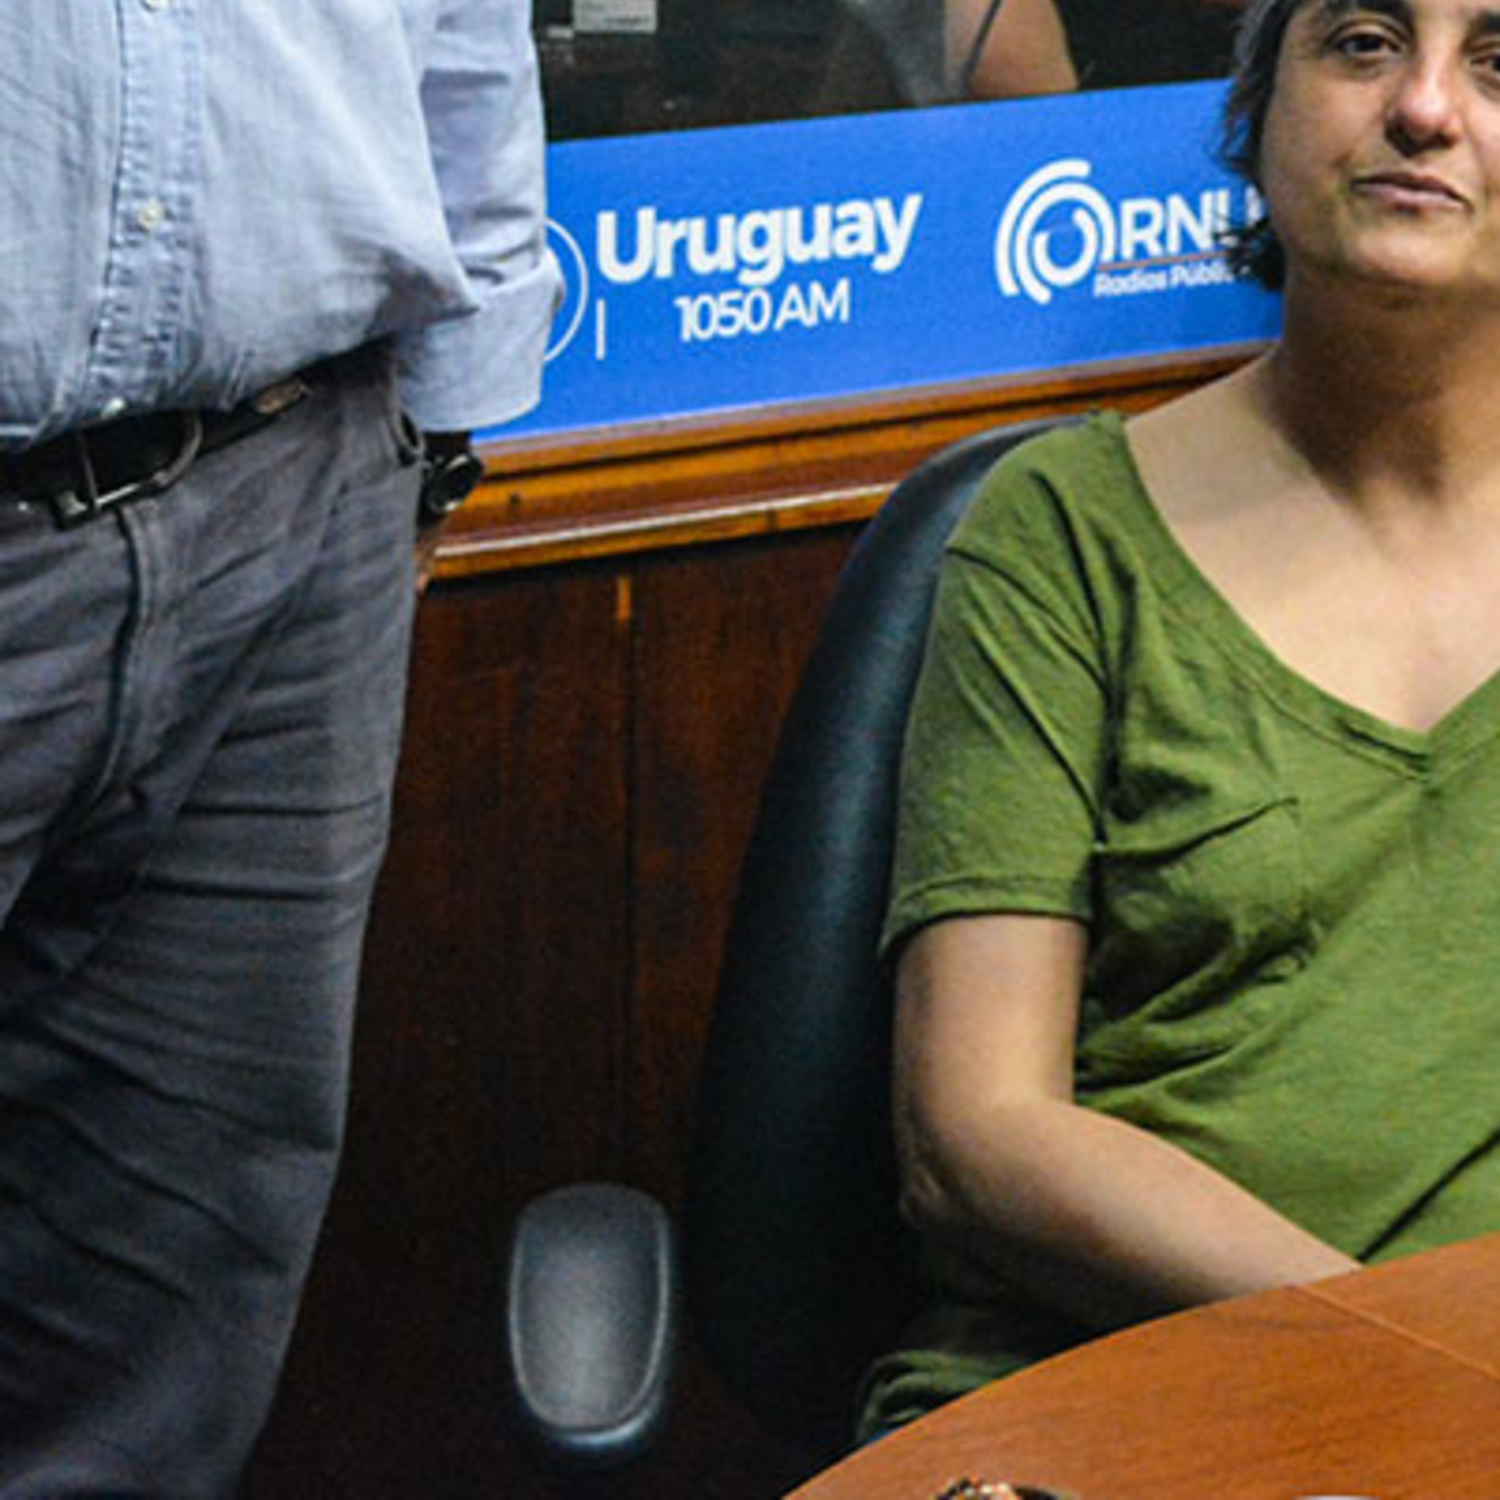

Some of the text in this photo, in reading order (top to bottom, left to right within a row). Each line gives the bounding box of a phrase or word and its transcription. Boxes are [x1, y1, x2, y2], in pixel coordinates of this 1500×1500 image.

[596, 194, 923, 284] Uruguay
[674, 278, 849, 342] 1050 AM
